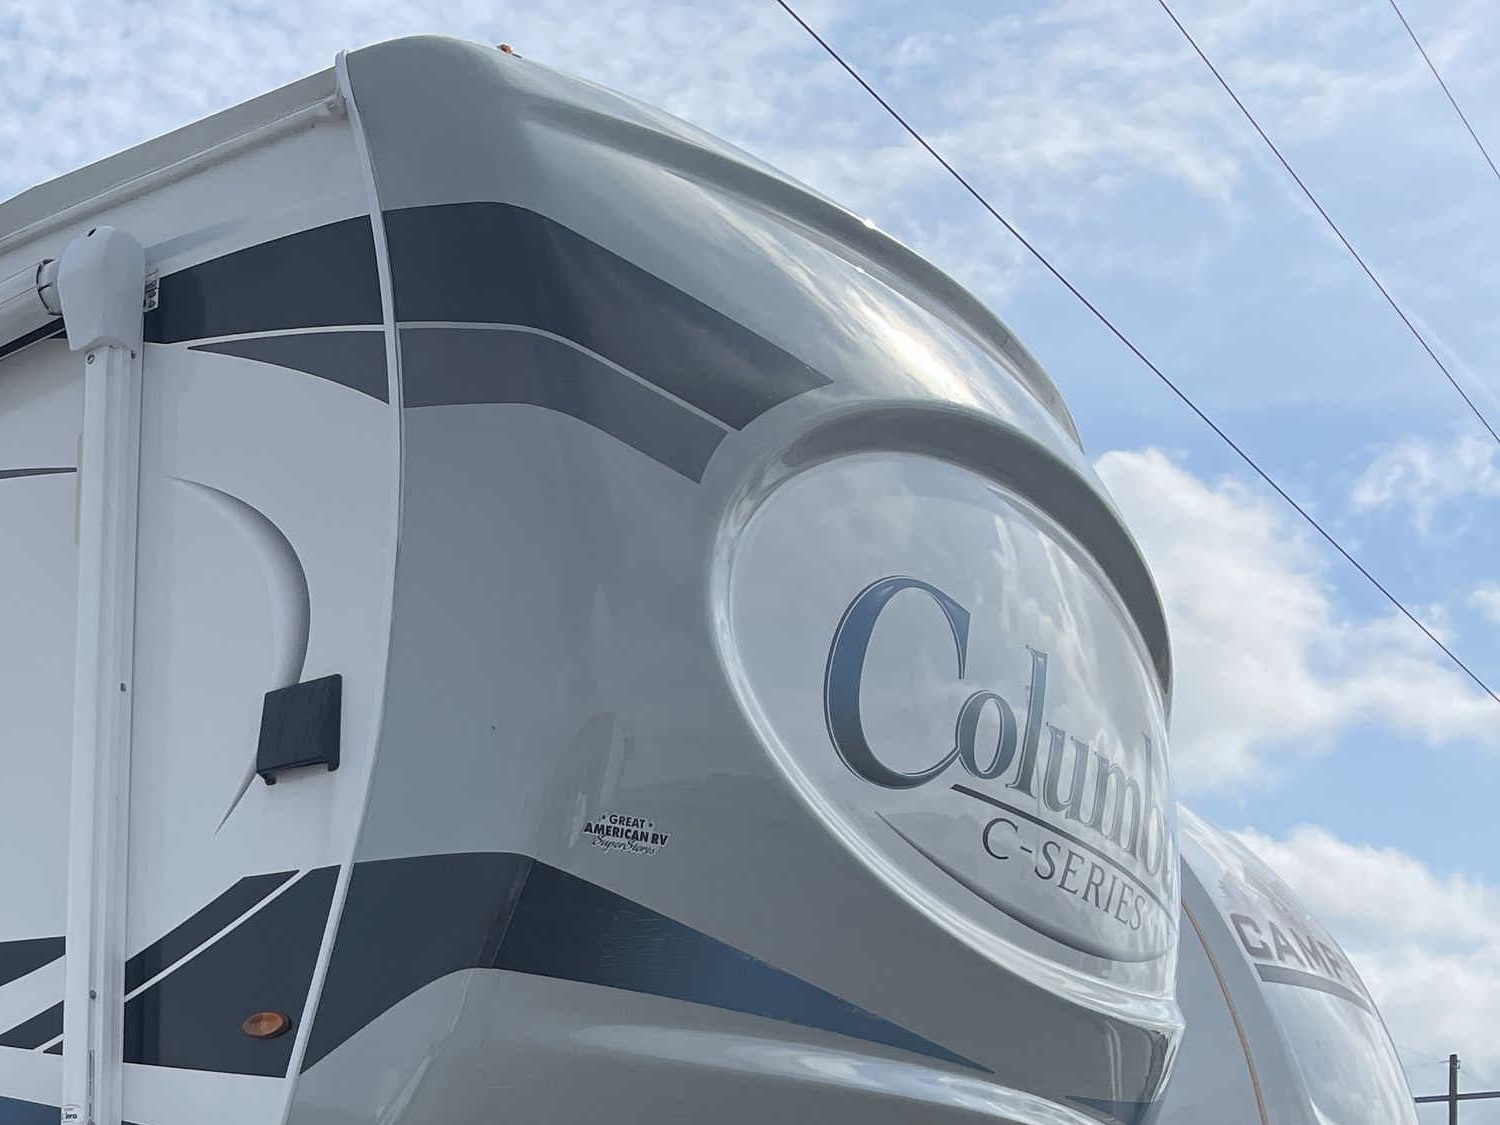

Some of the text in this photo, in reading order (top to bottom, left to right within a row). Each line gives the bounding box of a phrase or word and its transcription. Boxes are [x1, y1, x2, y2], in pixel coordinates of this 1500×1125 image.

[609, 814, 646, 829] GREAT
[584, 822, 669, 846] AMERICAN RV
[982, 817, 1147, 931] C-SERIES
